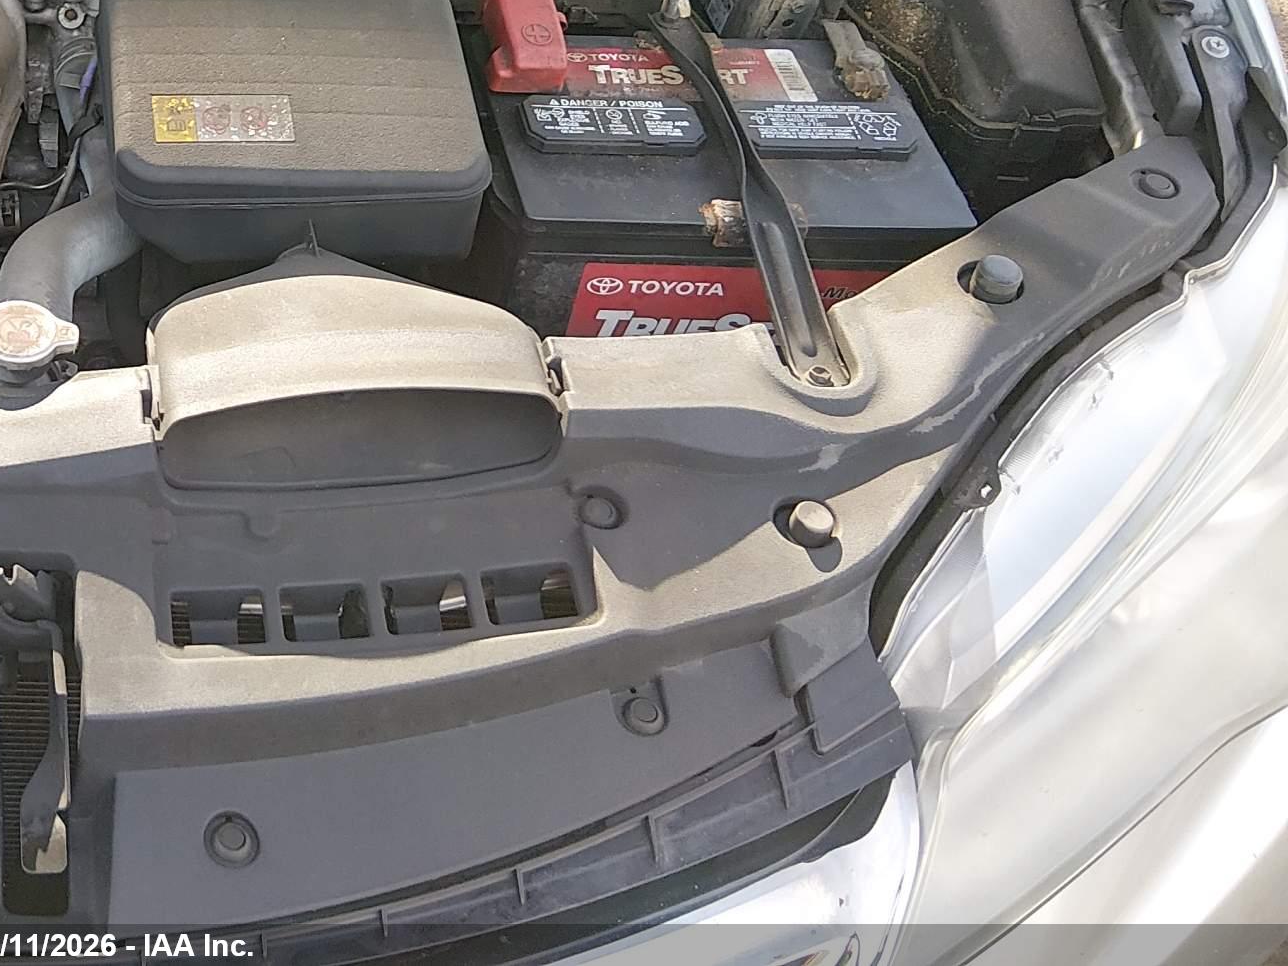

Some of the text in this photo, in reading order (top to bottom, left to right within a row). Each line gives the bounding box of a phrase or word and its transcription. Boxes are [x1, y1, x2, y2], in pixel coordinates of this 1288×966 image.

[588, 52, 649, 63] TOYOTA
[560, 98, 608, 107] DANGER
[618, 100, 664, 108] POISON
[628, 279, 724, 297] TOYOTA
